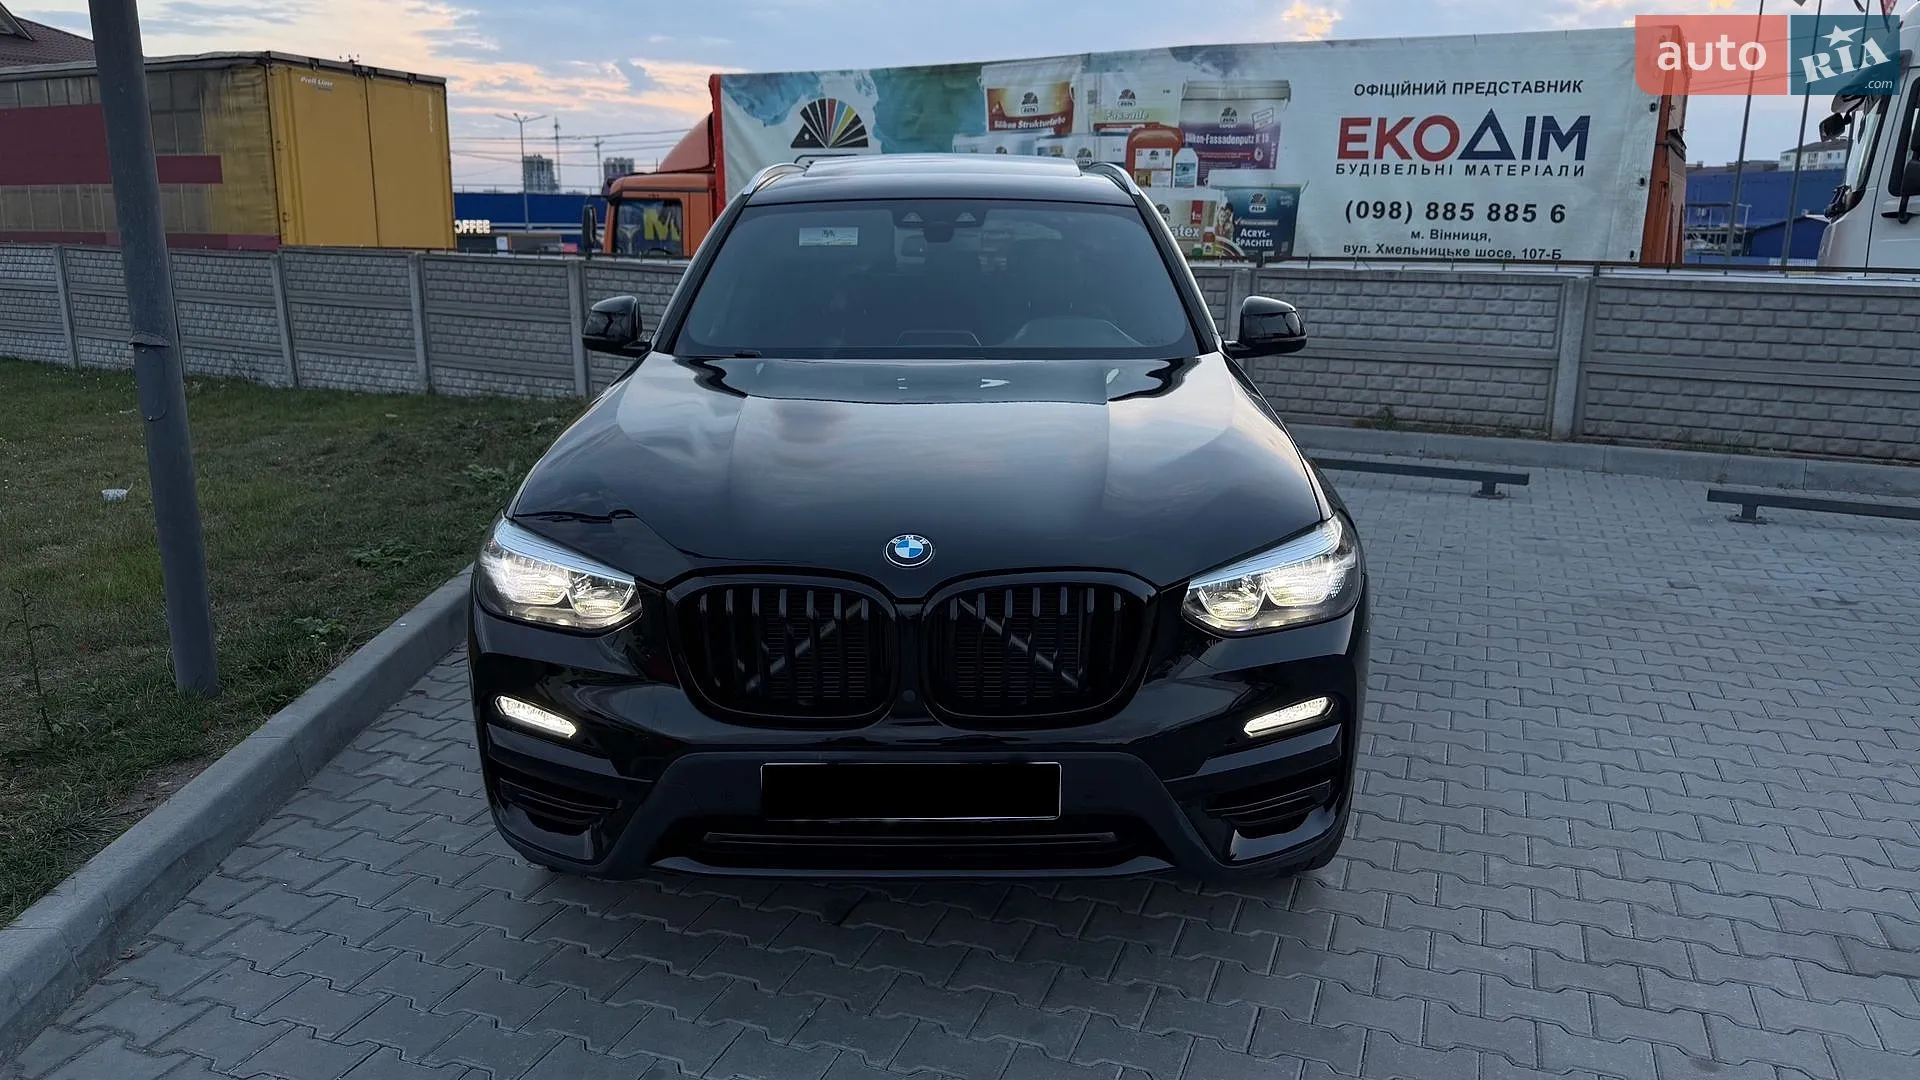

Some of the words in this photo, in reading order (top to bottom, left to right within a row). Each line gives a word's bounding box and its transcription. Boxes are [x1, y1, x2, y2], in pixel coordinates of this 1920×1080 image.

[1353, 80, 1447, 98] ОФІЦІЙНИЙ
[1452, 79, 1584, 96] ПРЕДСТАВНИК
[1335, 163, 1454, 177] БУДІВЕЛЬНІ
[1464, 164, 1585, 178] МАТЕРІАЛИ
[1345, 200, 1413, 224] (098)
[1425, 202, 1475, 222] 885
[1486, 203, 1537, 223] 885
[1550, 204, 1566, 224] 6
[1411, 230, 1425, 240] м.
[1430, 229, 1492, 243] Вінниця,
[1343, 244, 1371, 256] вул.
[1375, 243, 1471, 257] Хмельницьке
[1521, 248, 1562, 260] 107-Б
